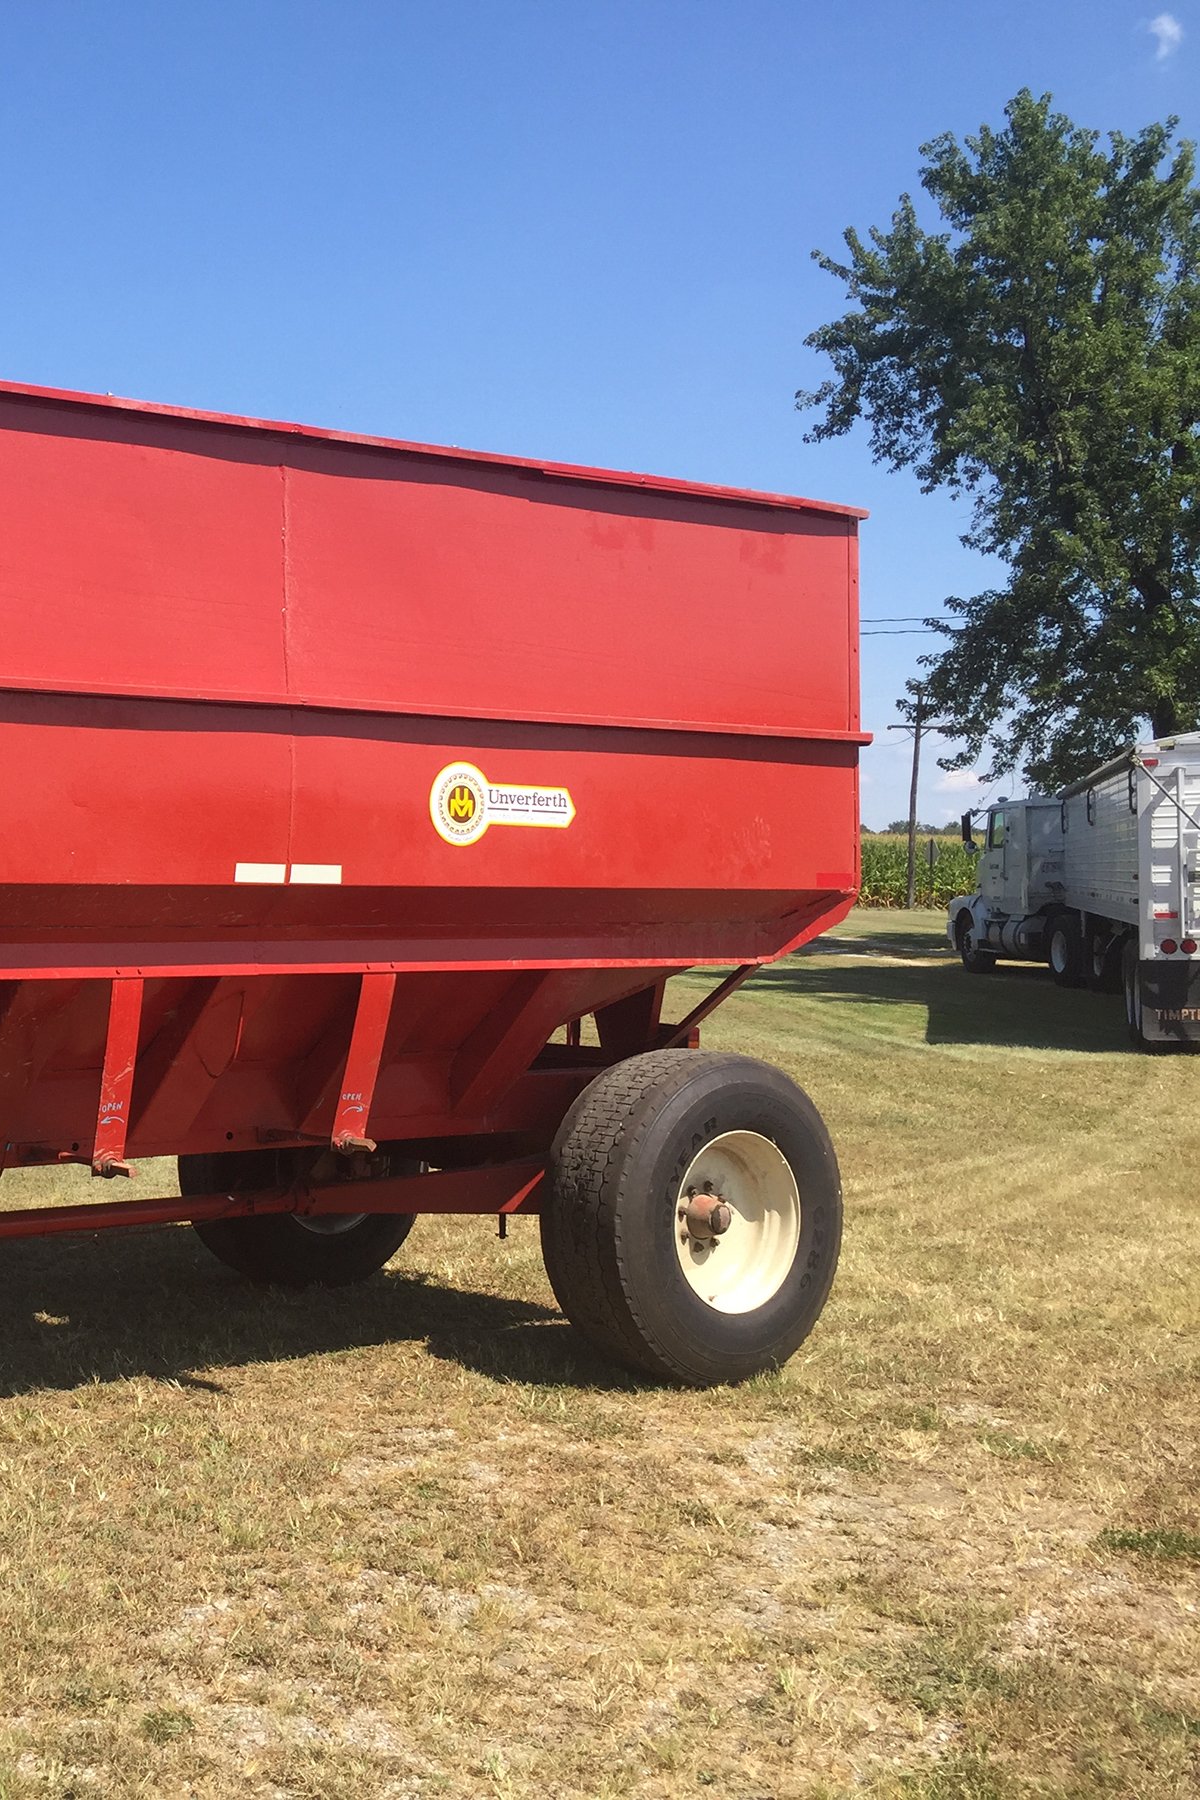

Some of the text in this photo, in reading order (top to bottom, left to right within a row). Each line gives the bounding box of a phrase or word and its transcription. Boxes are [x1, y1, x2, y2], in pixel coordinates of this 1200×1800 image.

[488, 789, 567, 808] Unverferth
[342, 1092, 362, 1101] OPEN
[102, 1100, 123, 1113] OPEN
